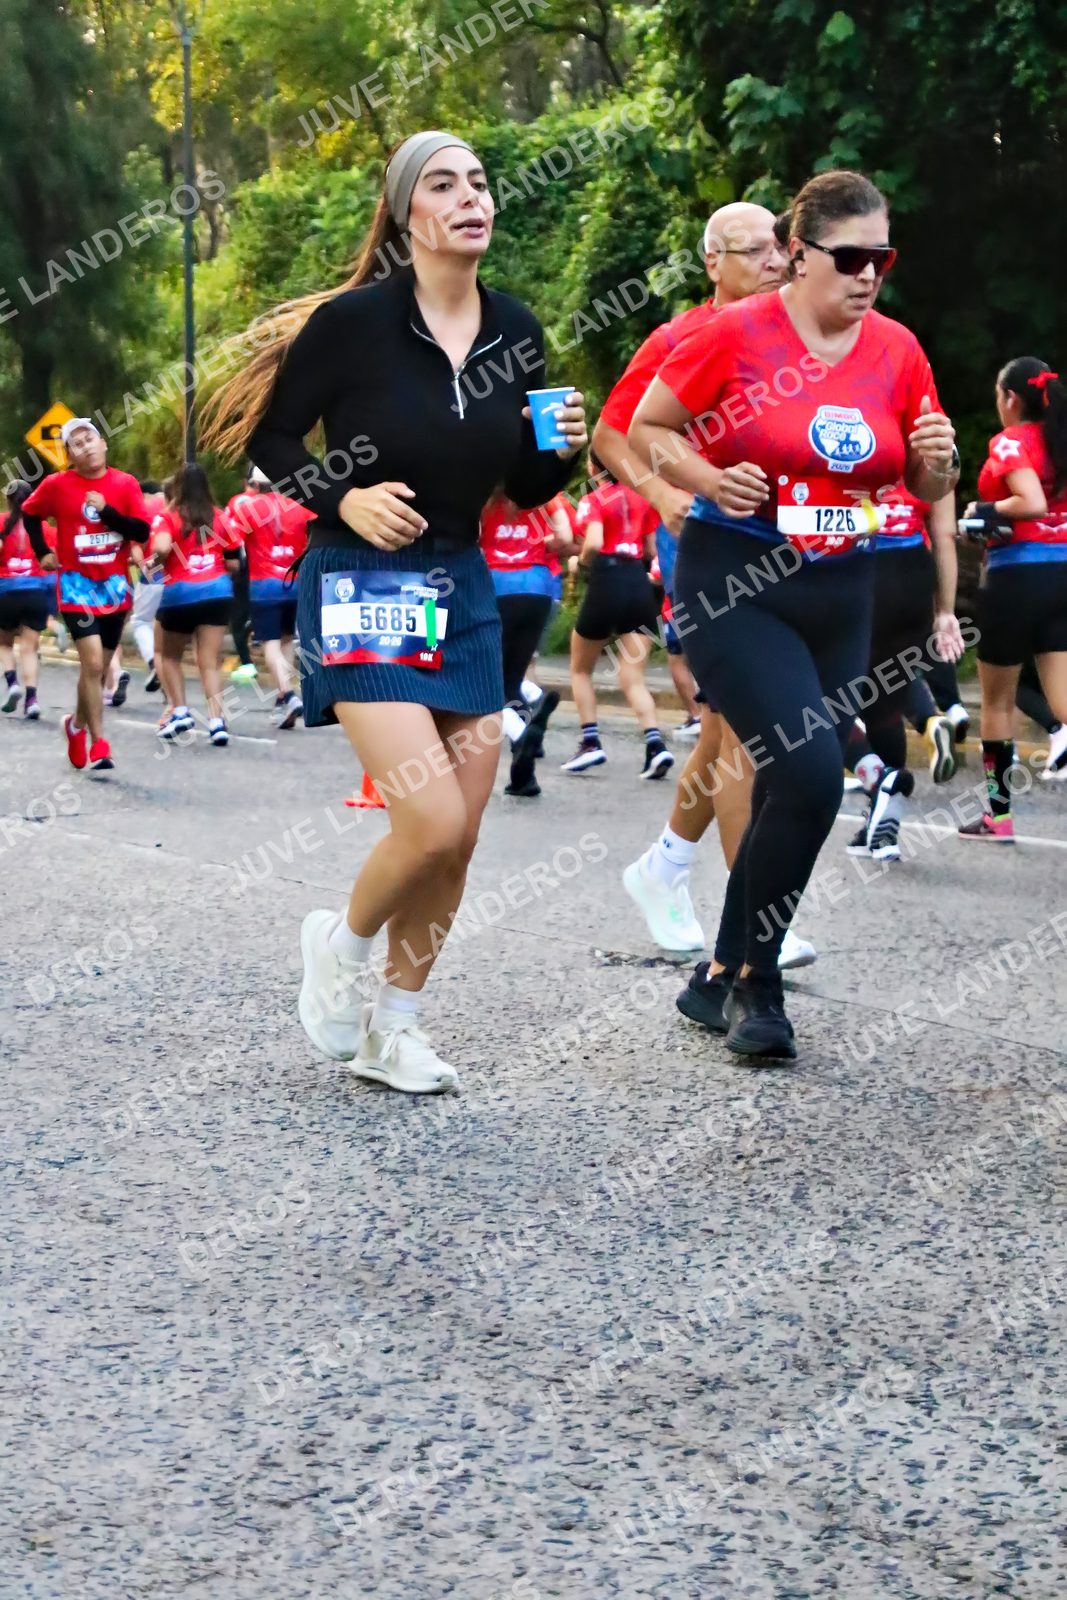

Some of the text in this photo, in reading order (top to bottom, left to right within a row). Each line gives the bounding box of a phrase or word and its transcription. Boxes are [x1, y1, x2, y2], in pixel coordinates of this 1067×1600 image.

[815, 508, 856, 532] 1226
[89, 533, 110, 545] 2577
[360, 605, 417, 633] 5685
